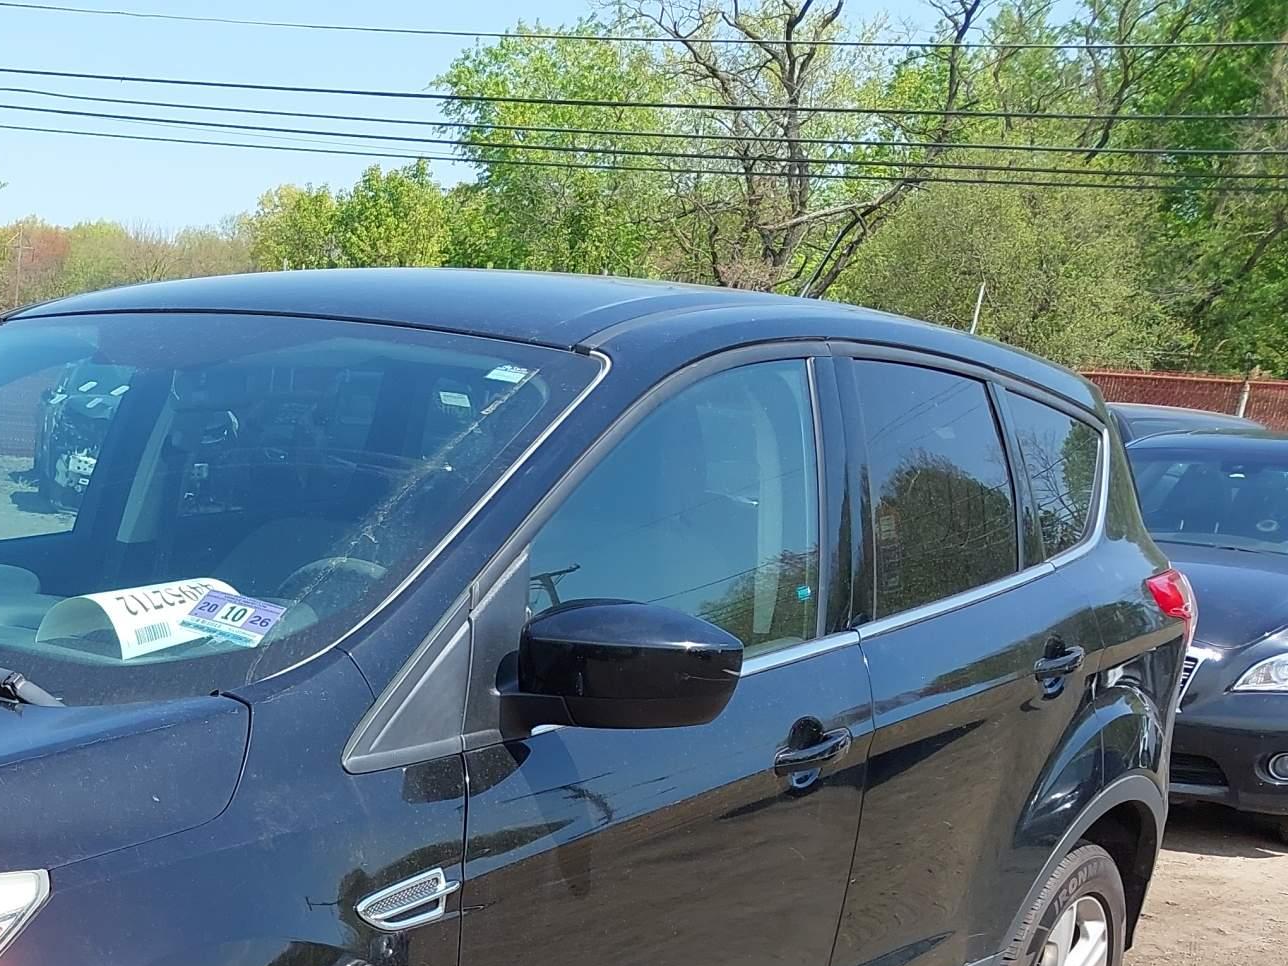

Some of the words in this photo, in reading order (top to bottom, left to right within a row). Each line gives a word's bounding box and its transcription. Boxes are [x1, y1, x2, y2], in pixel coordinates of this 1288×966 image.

[114, 583, 213, 615] 44952712
[198, 601, 219, 613] 20
[221, 605, 248, 622] 10
[249, 615, 271, 628] 26
